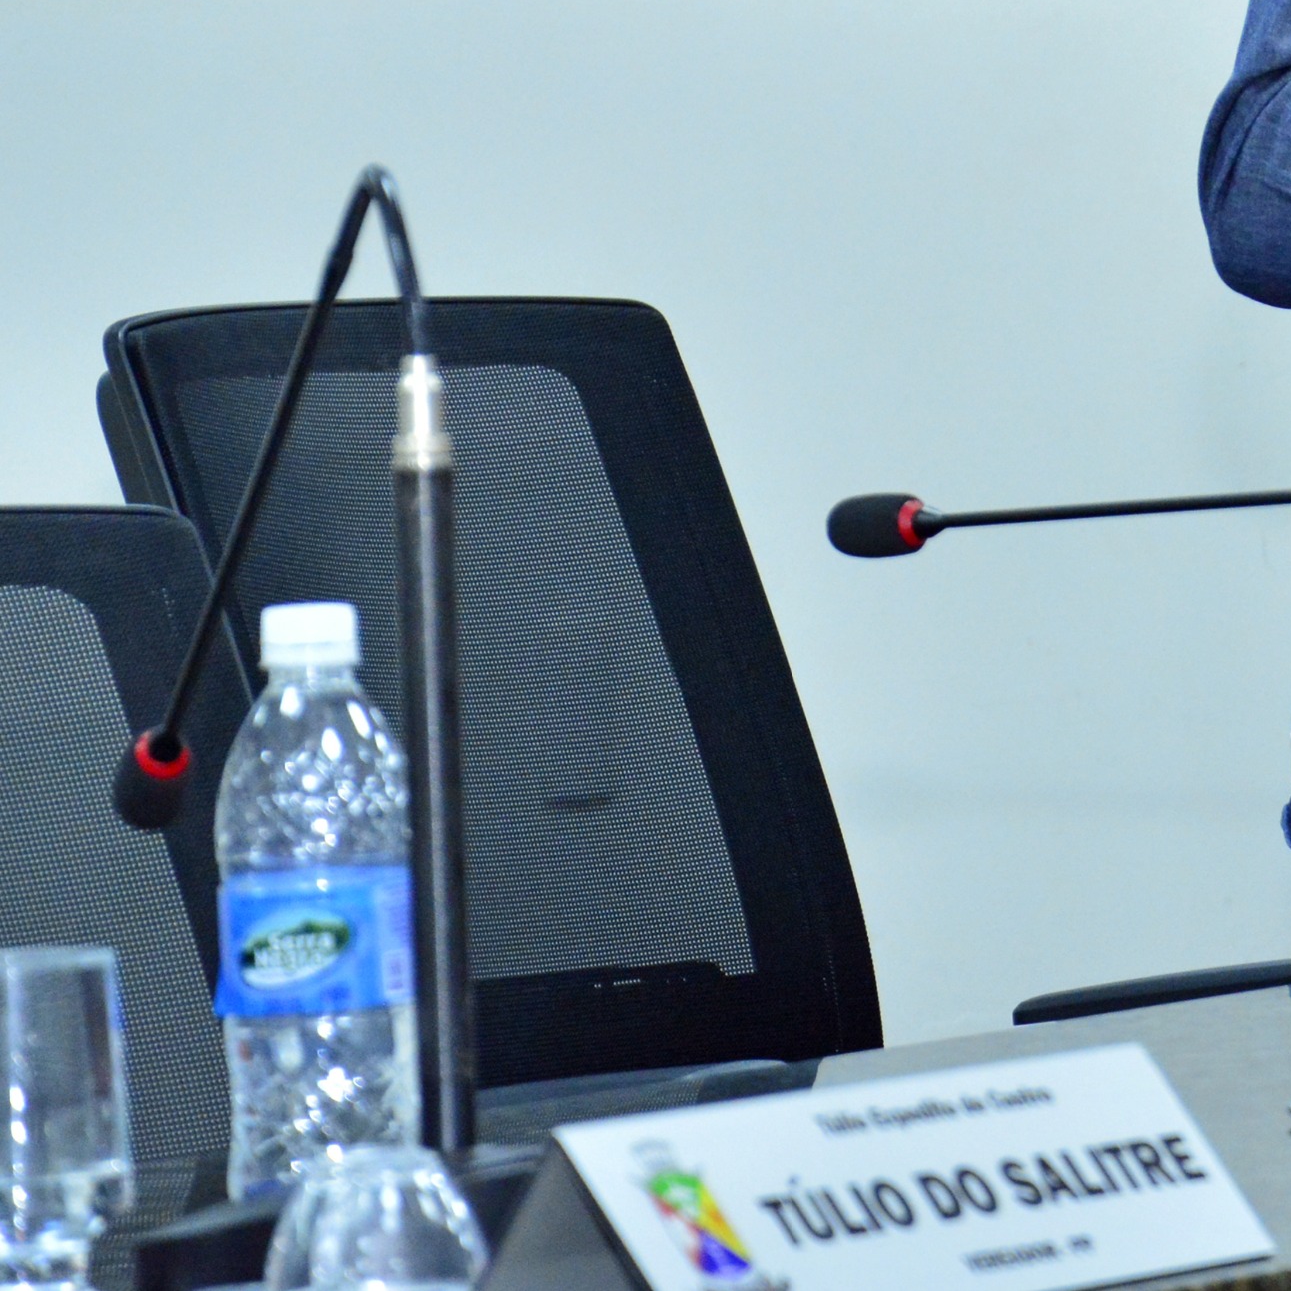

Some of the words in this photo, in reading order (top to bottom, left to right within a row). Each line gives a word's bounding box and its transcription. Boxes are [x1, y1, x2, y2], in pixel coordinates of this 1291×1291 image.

[268, 931, 335, 950] Serra
[760, 1174, 914, 1247] TÚLIO
[917, 1167, 999, 1221] DO
[1000, 1134, 1206, 1207] SALITRE
